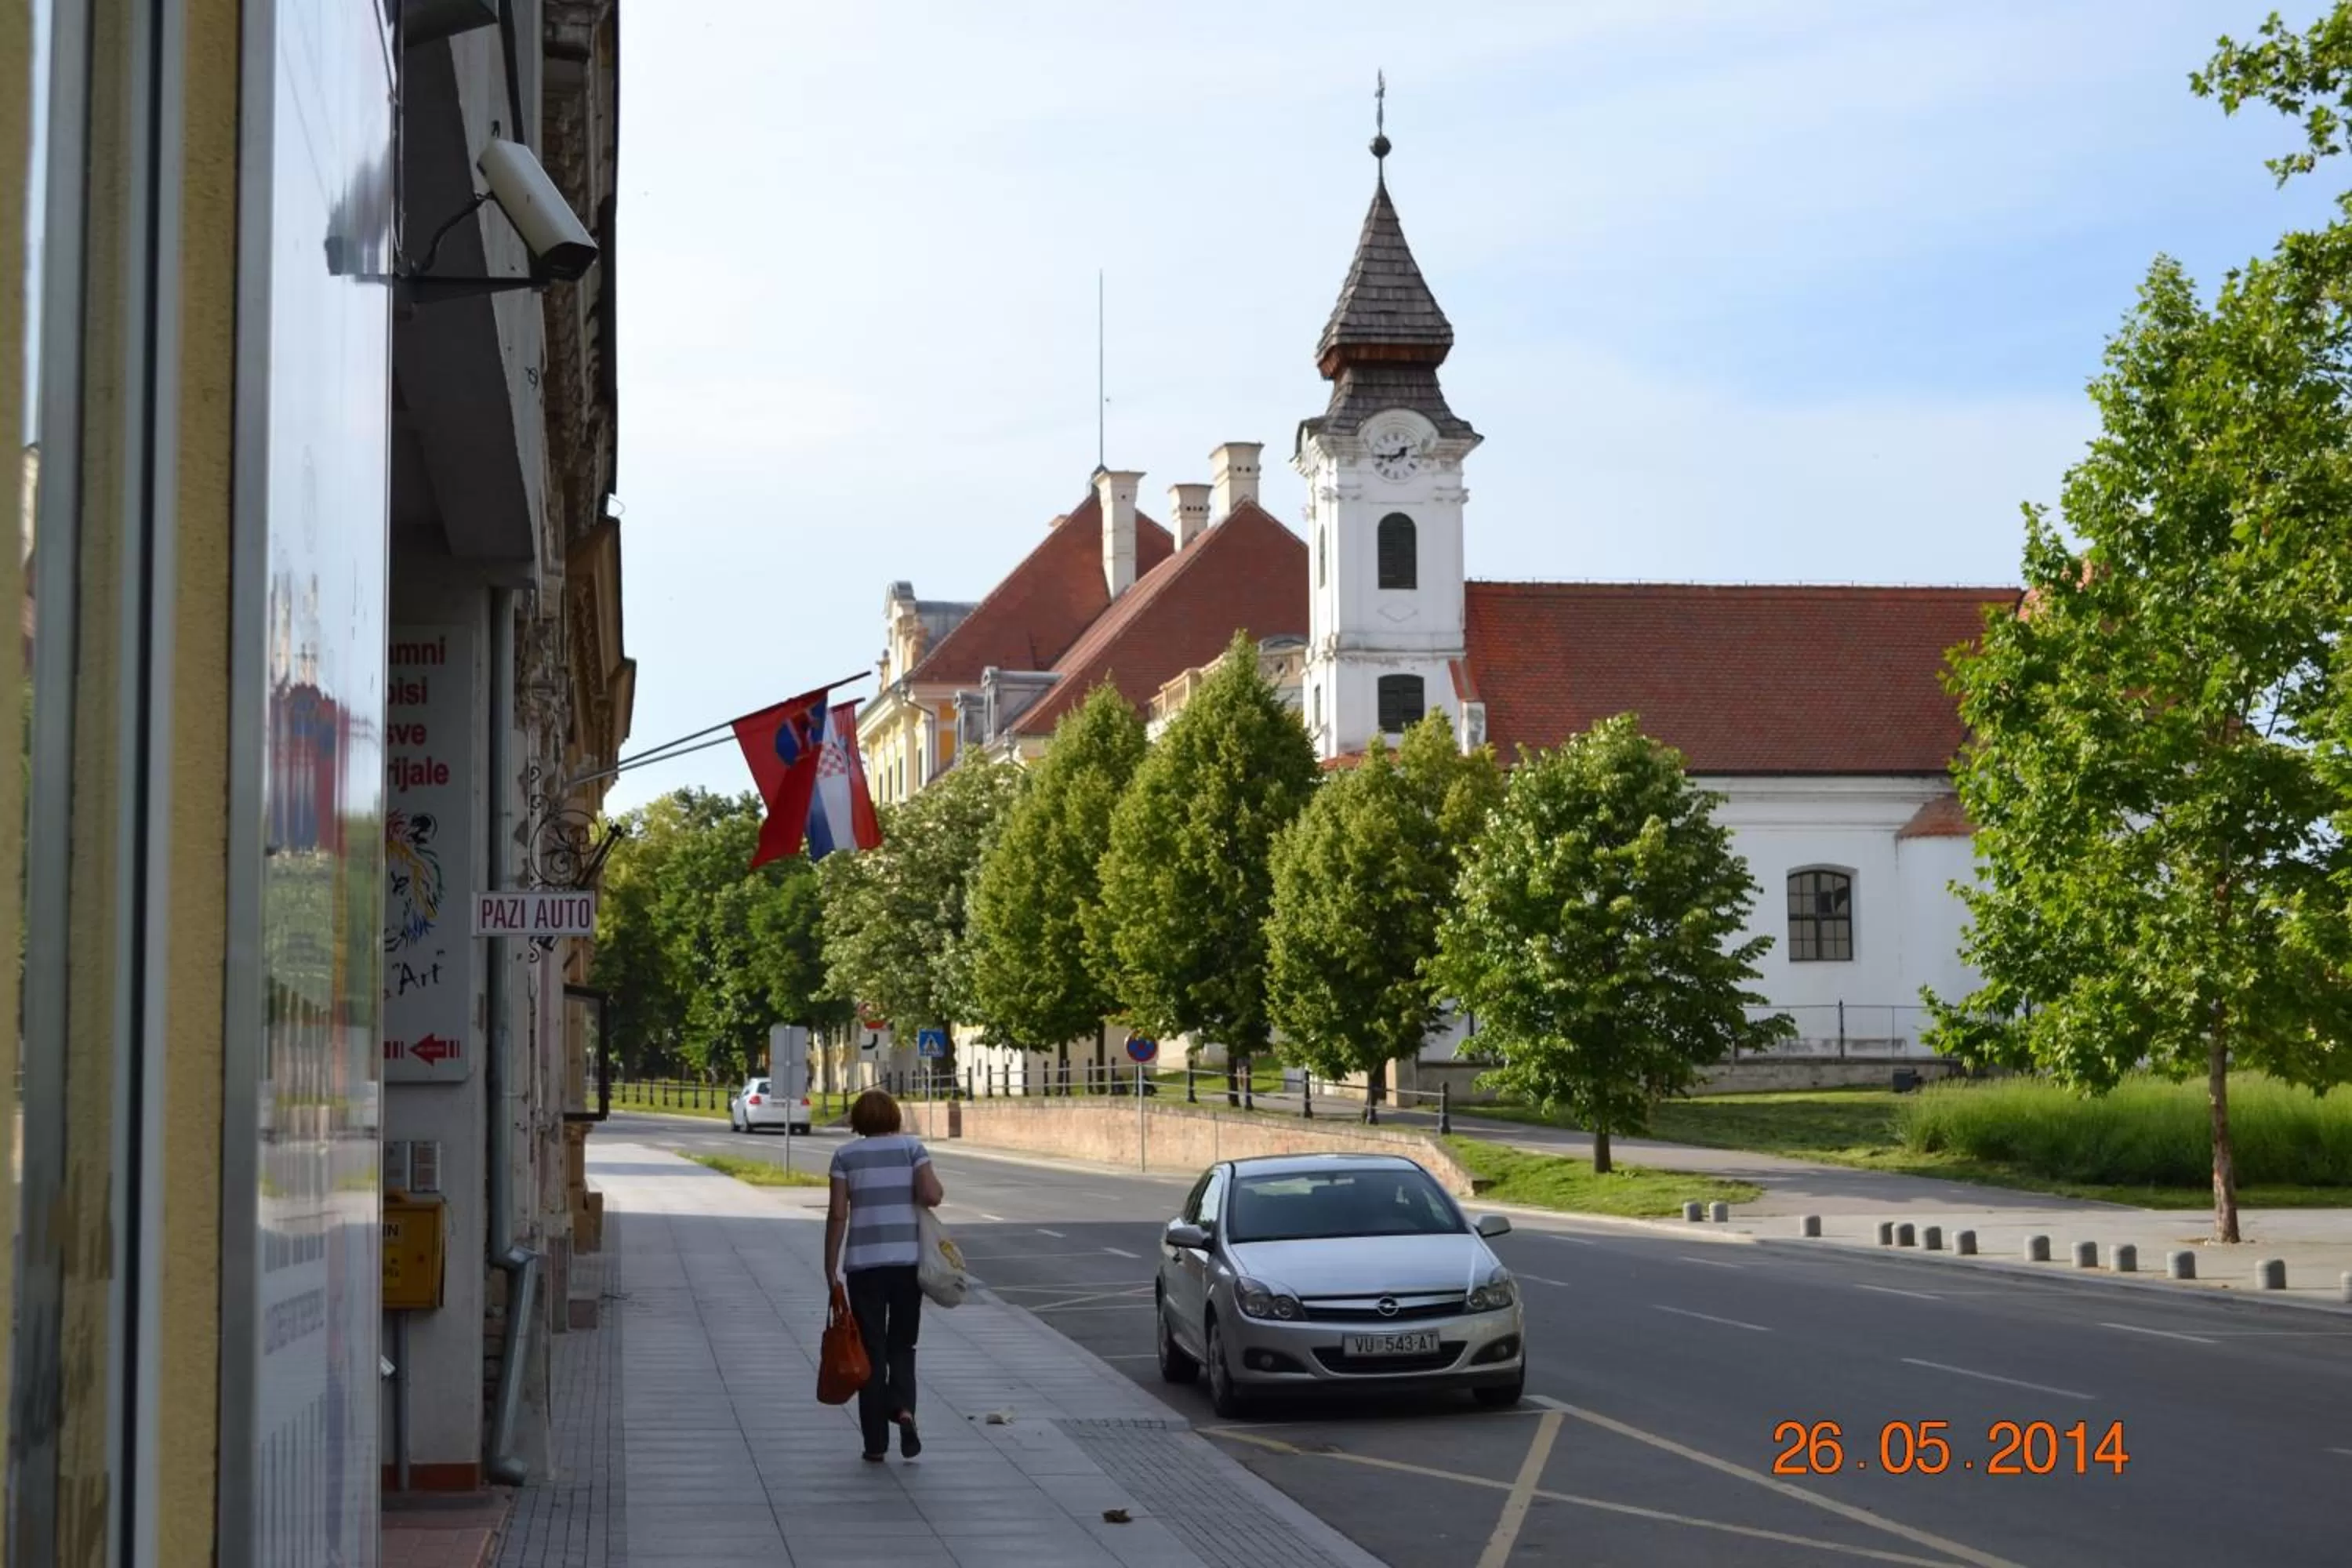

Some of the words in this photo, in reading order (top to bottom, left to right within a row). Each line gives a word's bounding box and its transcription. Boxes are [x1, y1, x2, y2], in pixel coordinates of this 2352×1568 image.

[481, 898, 526, 929] PAZI
[534, 898, 590, 929] AUTO
[1355, 1335, 1374, 1352] VU
